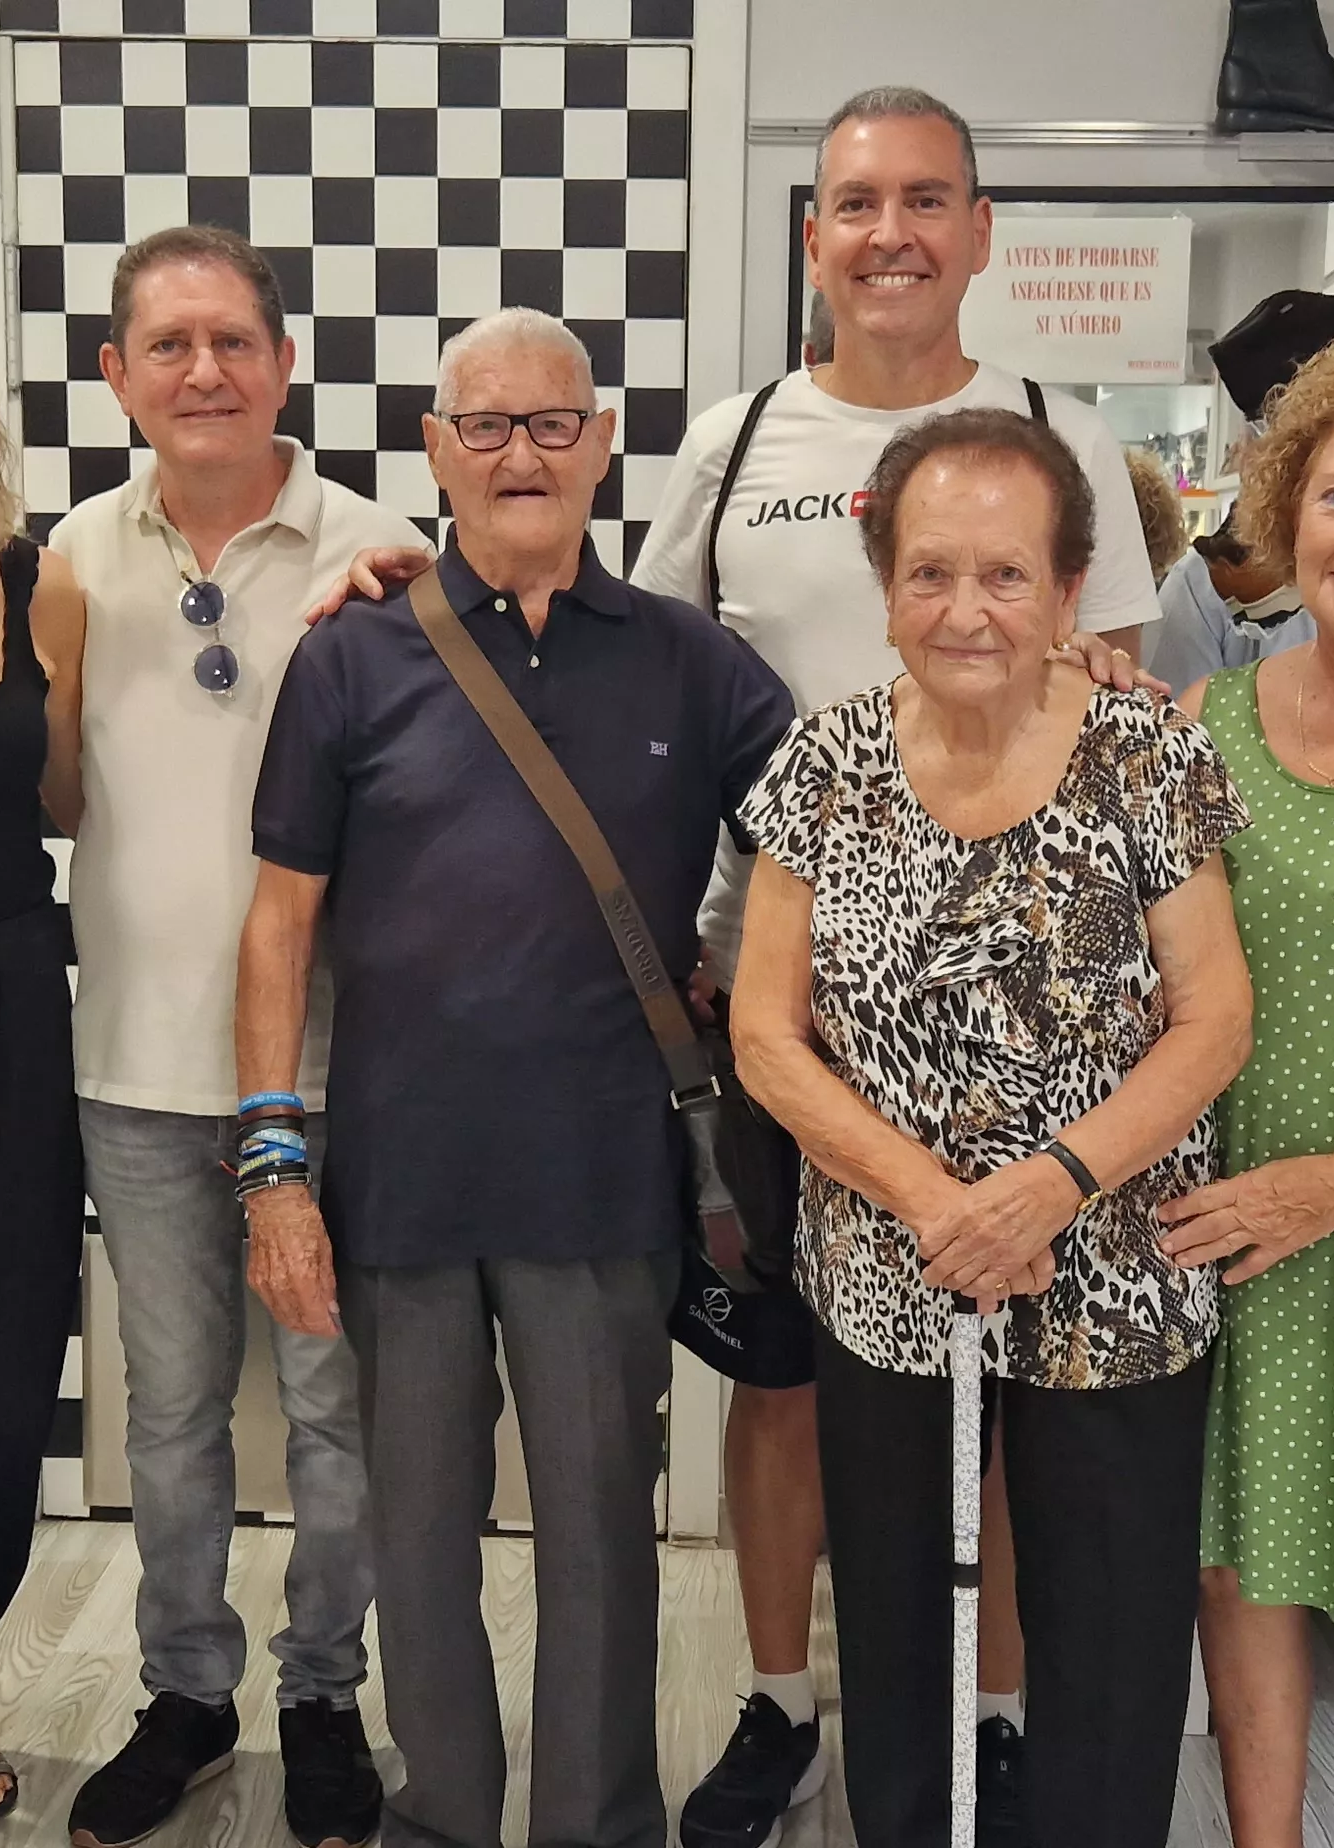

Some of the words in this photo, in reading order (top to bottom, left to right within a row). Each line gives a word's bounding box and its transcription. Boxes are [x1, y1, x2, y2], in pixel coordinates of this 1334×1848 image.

[1004, 247, 1051, 267] ANTES
[1055, 247, 1075, 267] DE
[1079, 247, 1160, 267] PROBARSE
[1009, 277, 1095, 301] ASEGÚRESE
[1099, 281, 1129, 302] QUE
[1133, 281, 1152, 301] ES
[1036, 314, 1053, 335] SU
[1060, 310, 1122, 335] NÚMERO
[747, 491, 848, 529] JACK
